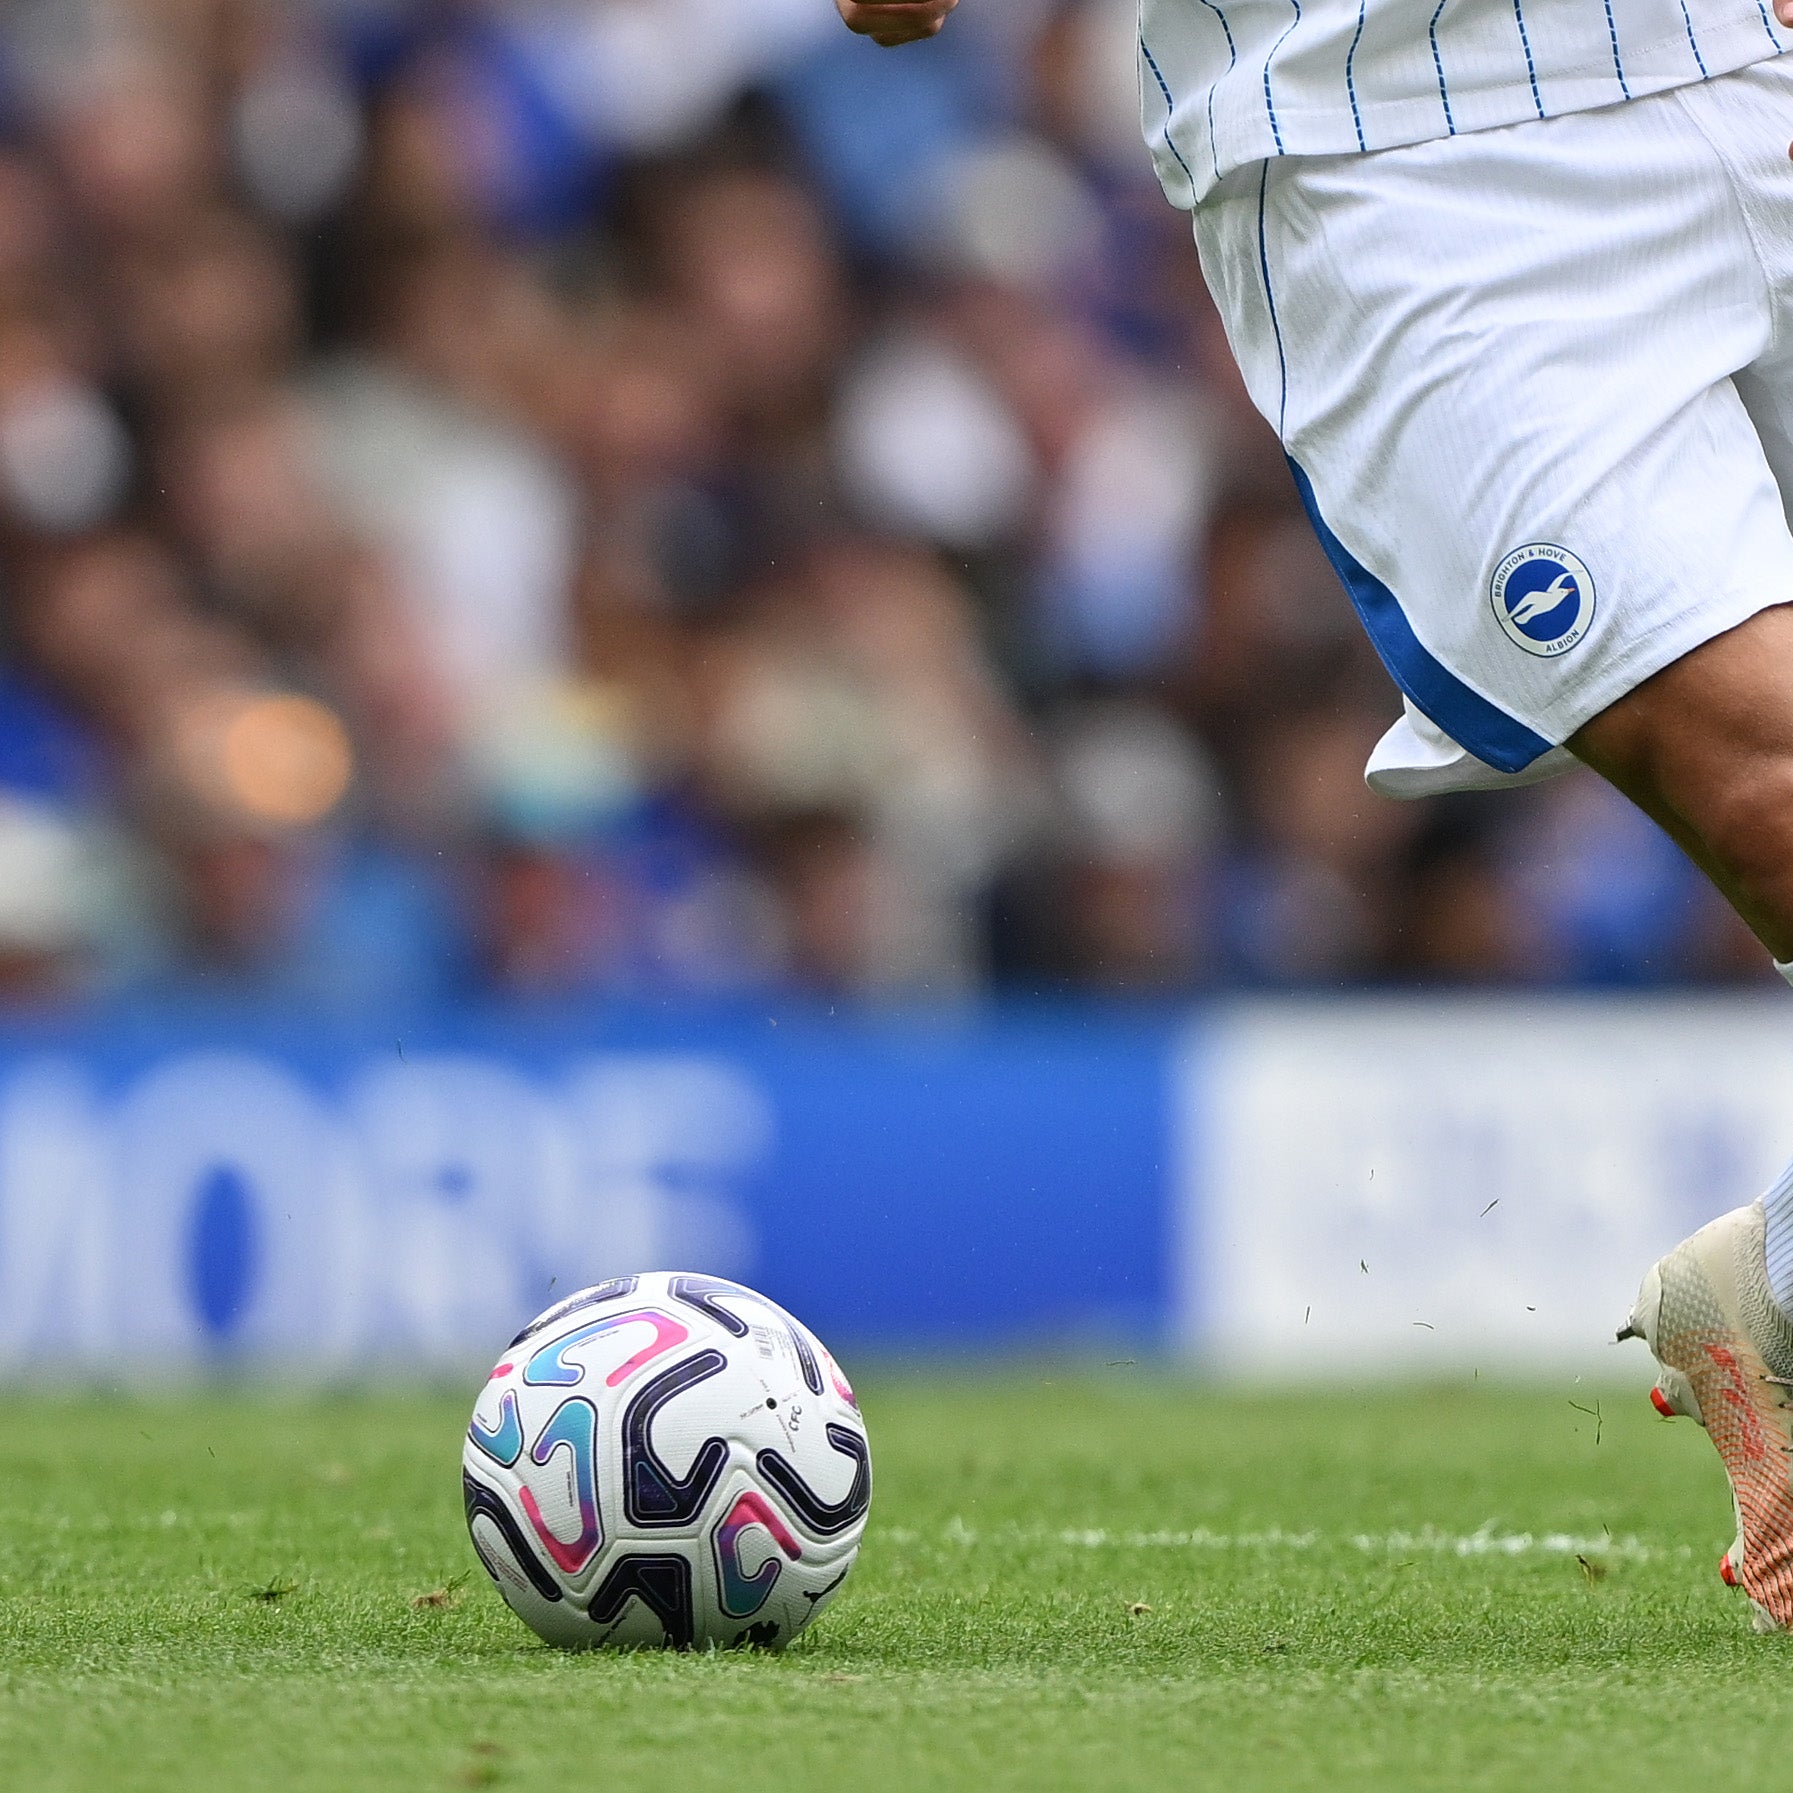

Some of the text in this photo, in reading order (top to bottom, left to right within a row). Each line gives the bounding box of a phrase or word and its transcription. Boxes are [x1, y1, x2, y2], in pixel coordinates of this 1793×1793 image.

[1494, 552, 1525, 597] BRIGHTON
[1538, 548, 1567, 562] HOVE
[1545, 629, 1580, 653] ALBION
[788, 1405, 803, 1432] CFC
